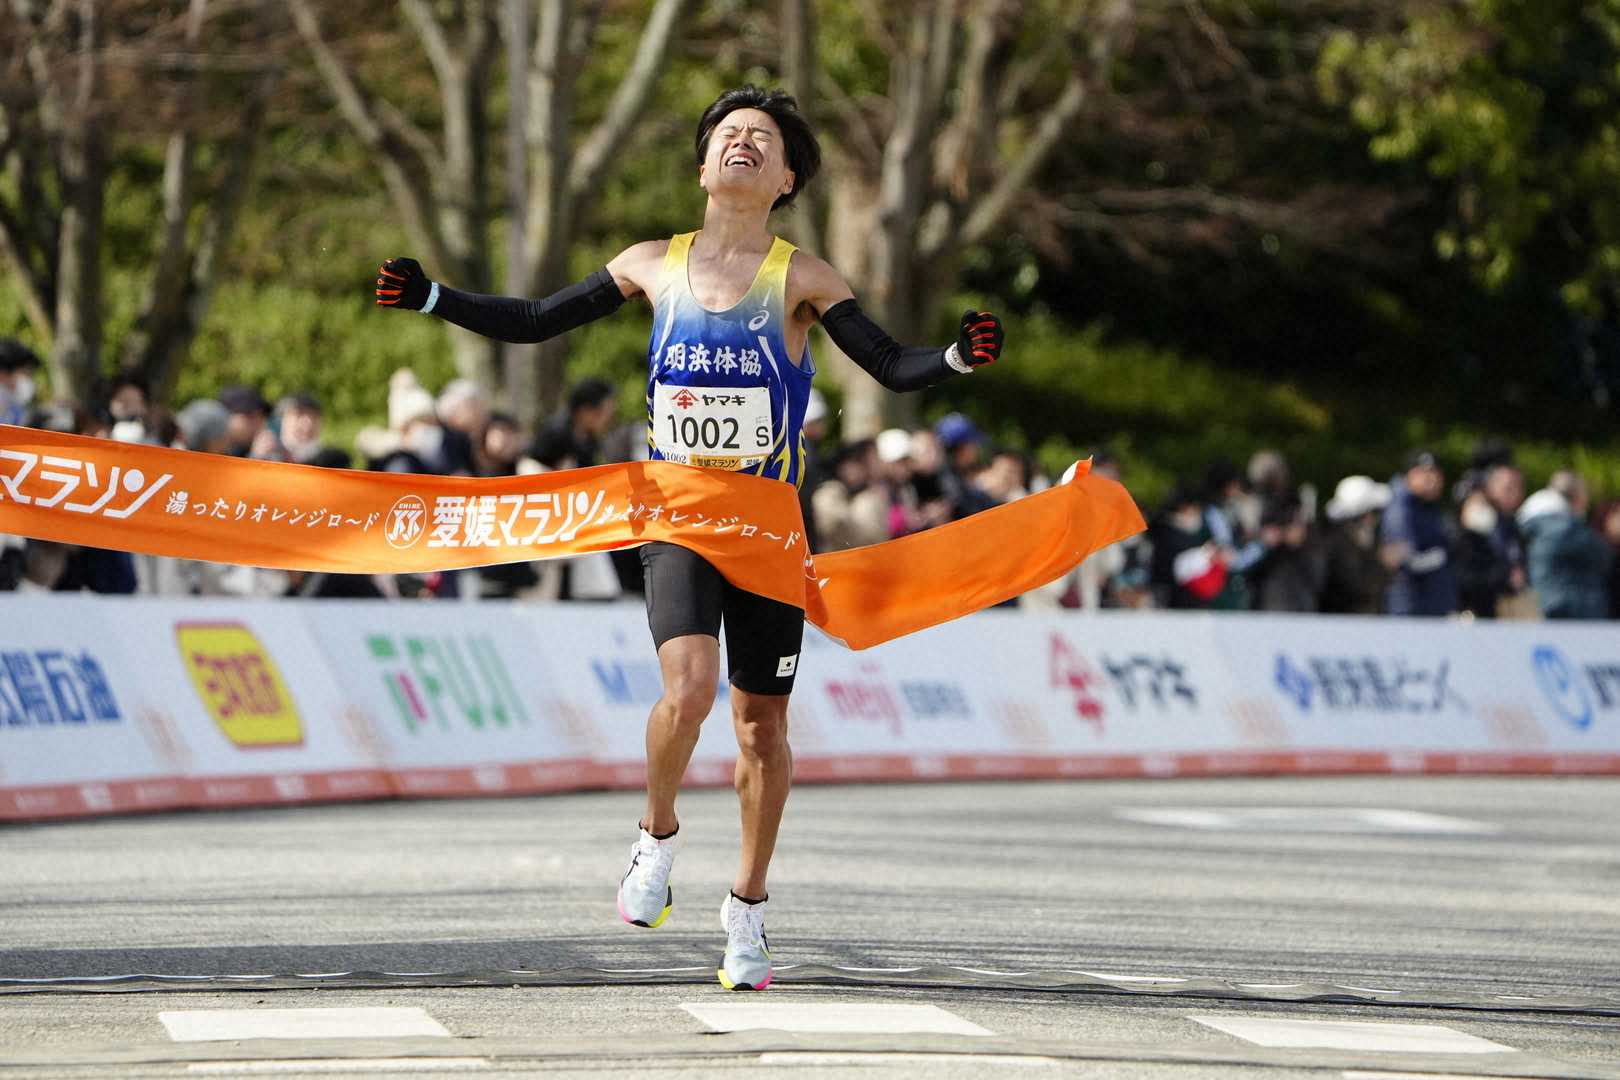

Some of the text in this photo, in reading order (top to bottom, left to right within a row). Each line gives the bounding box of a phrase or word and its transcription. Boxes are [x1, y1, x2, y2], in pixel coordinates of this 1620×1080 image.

[664, 343, 762, 377] 明浜体協
[702, 394, 746, 406] ヤマキ
[667, 414, 770, 449] 1002 S
[427, 489, 605, 548] 愛媛マラソン
